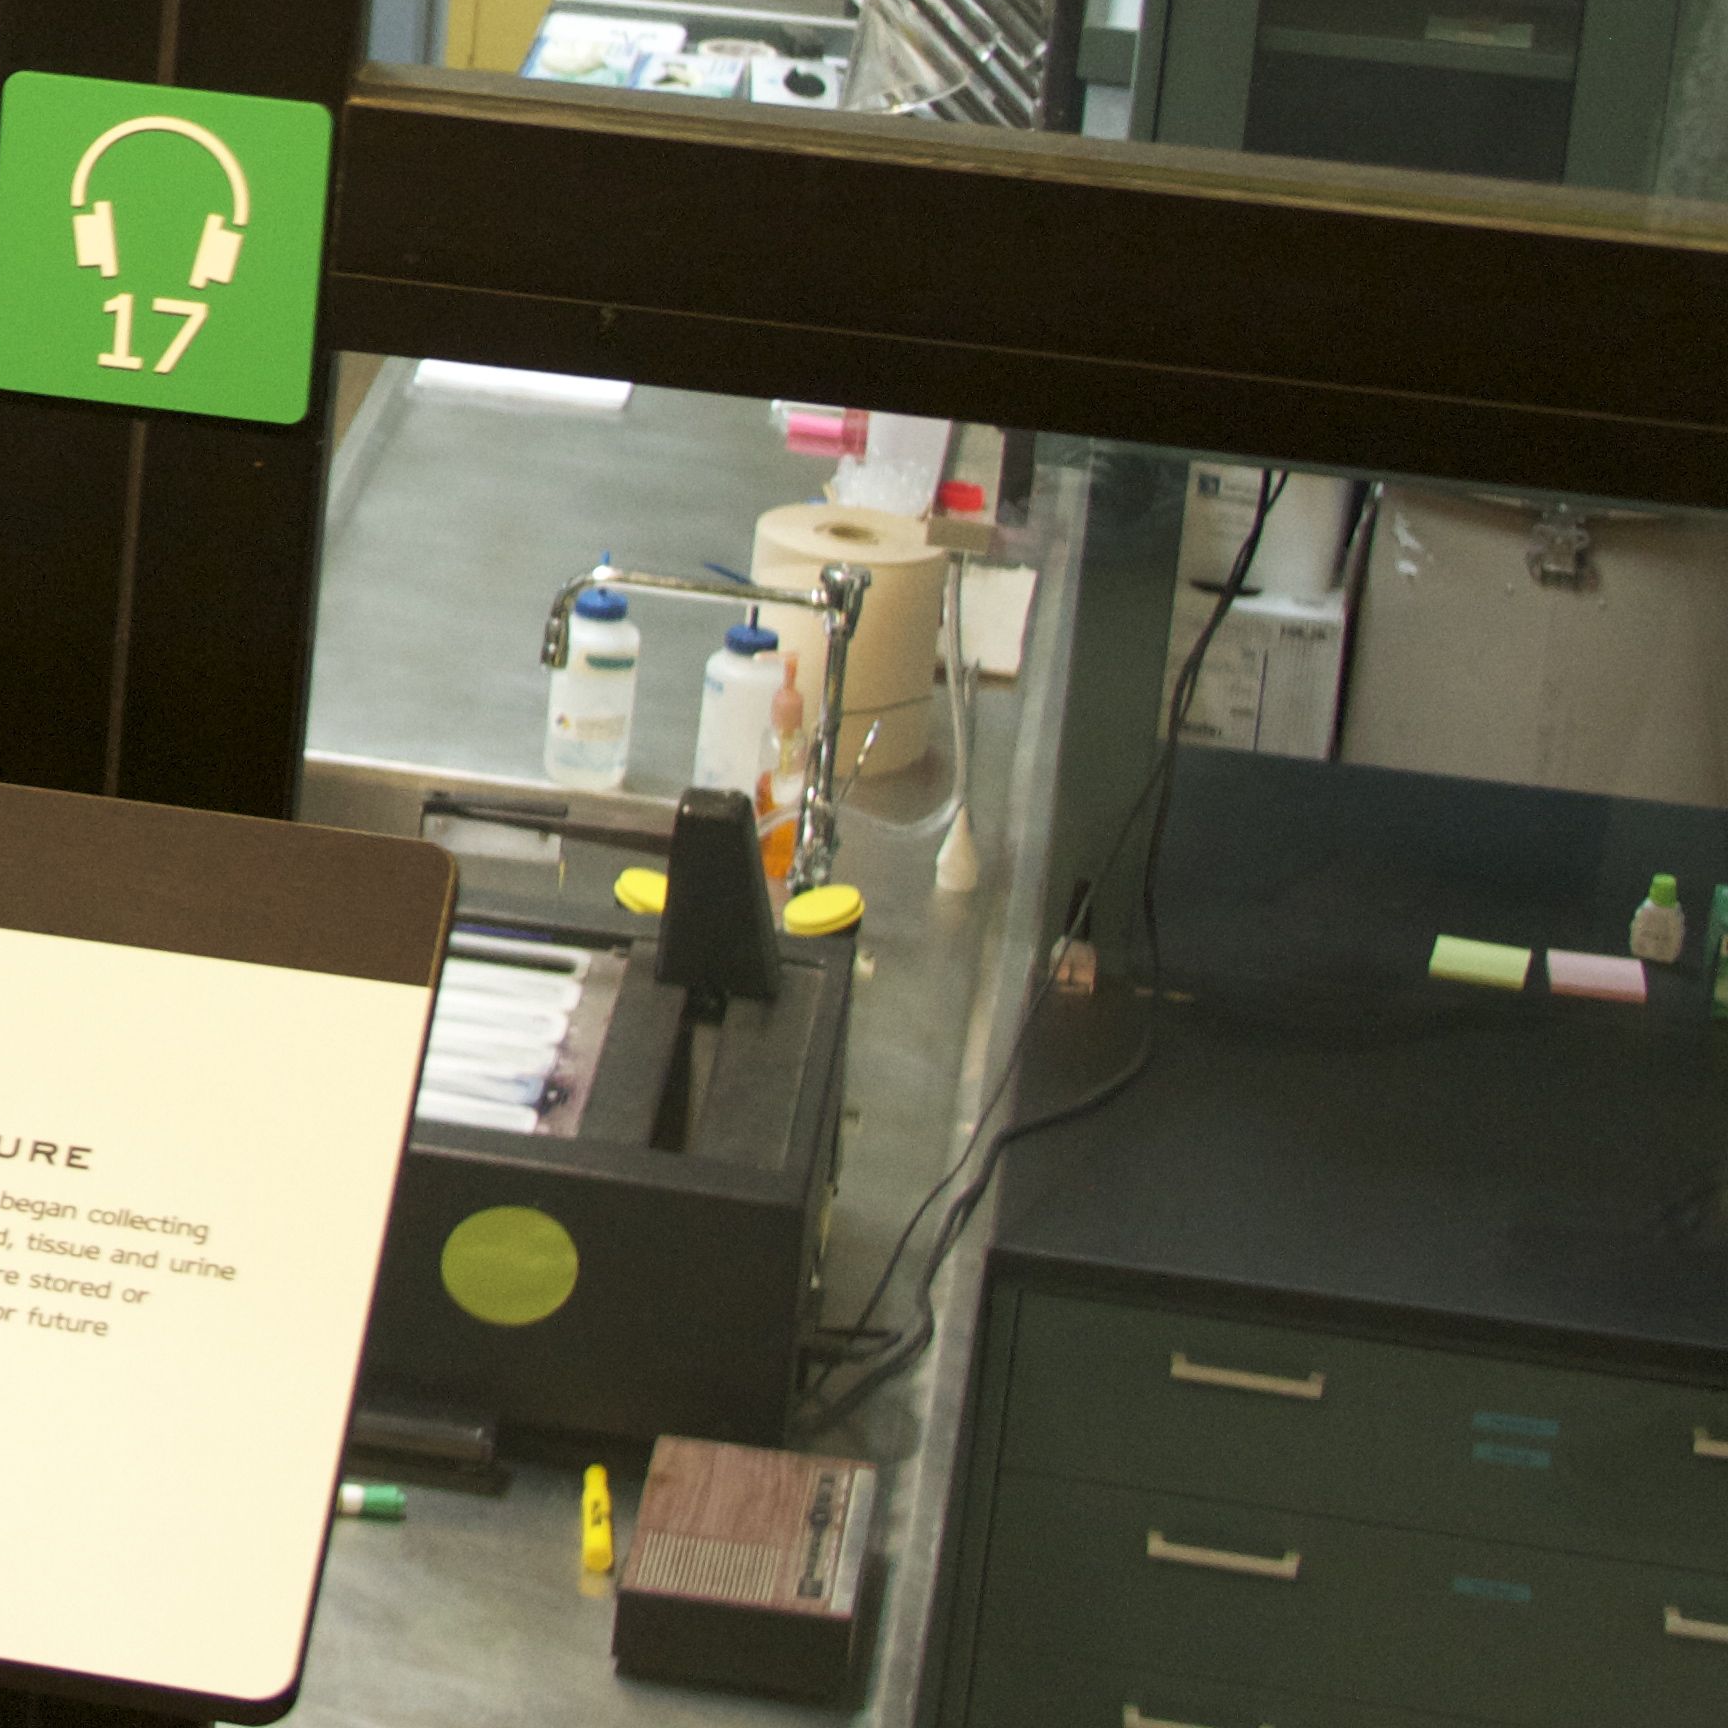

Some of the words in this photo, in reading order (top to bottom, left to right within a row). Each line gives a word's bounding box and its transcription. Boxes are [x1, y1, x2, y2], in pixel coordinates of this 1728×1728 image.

[97, 292, 209, 374] 17
[87, 1208, 210, 1246] collecting
[26, 1233, 102, 1261] tissue
[109, 1248, 160, 1270] and
[169, 1257, 237, 1282] urine
[29, 1273, 113, 1300] stored
[121, 1288, 151, 1304] or
[27, 1306, 109, 1337] future
